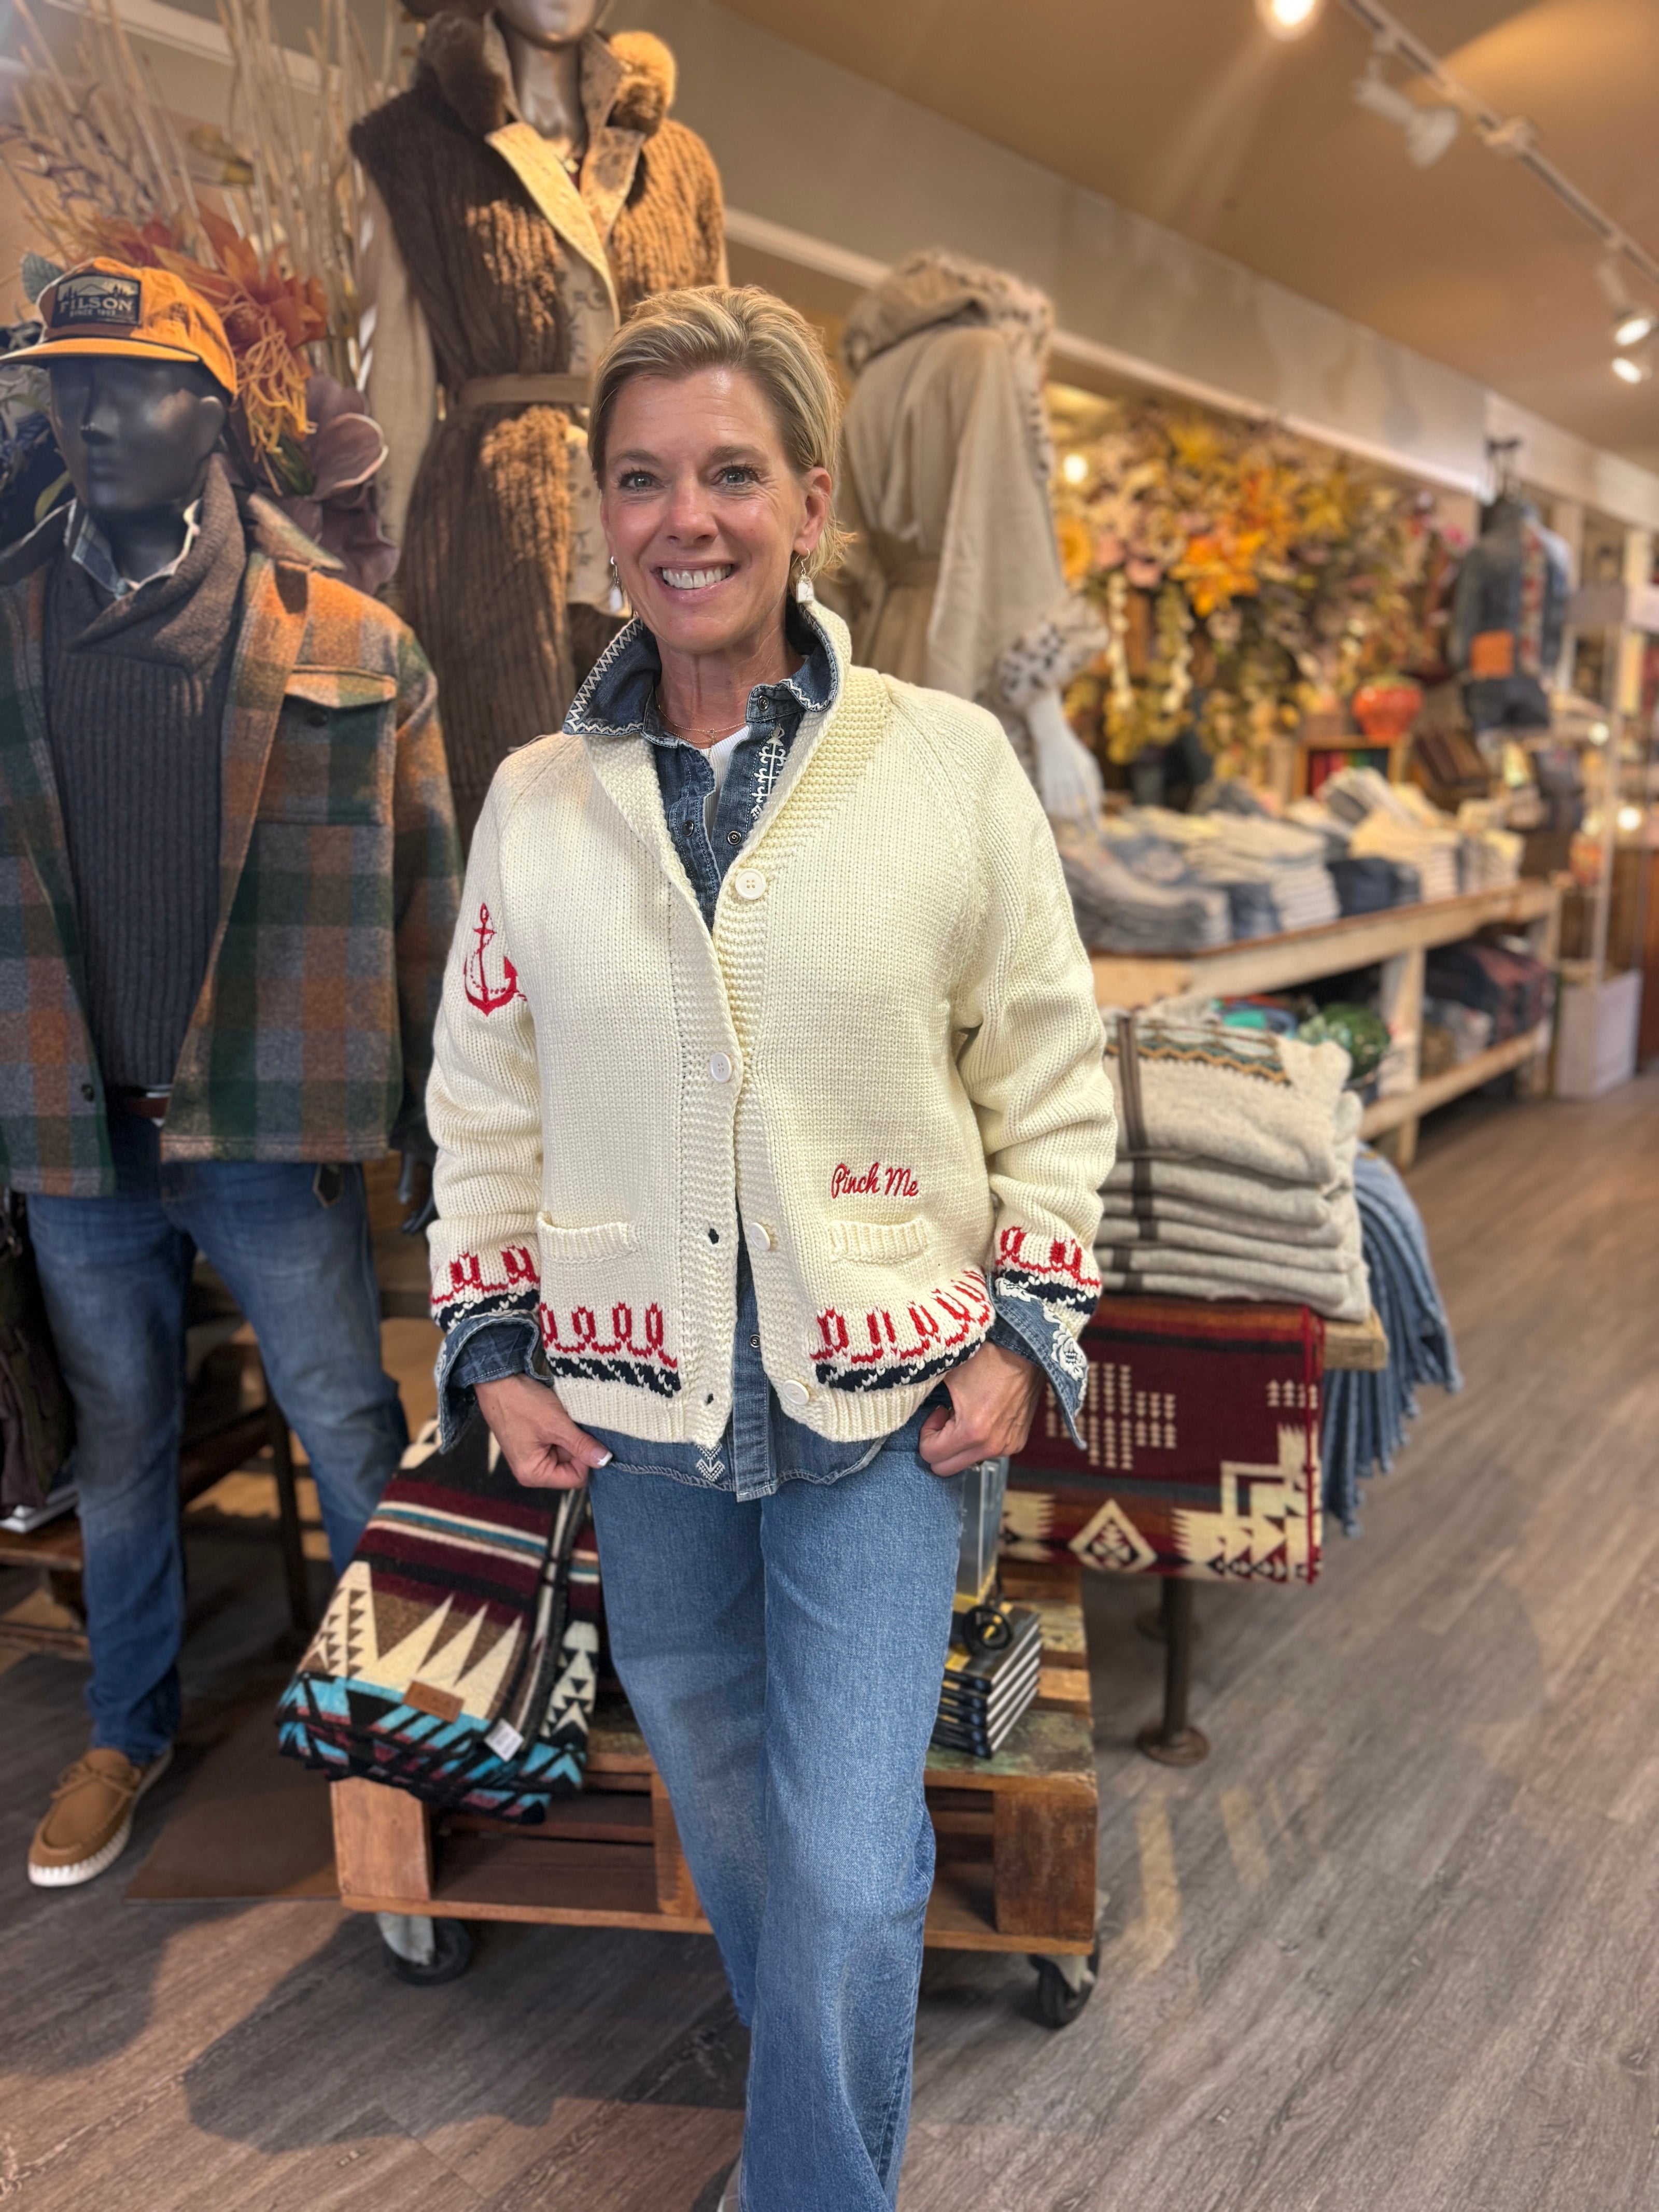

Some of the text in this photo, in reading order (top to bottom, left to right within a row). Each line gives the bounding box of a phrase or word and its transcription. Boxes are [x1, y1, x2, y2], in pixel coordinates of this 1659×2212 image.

[59, 295, 132, 314] FILSON
[831, 1162, 919, 1199] Pinch Me
